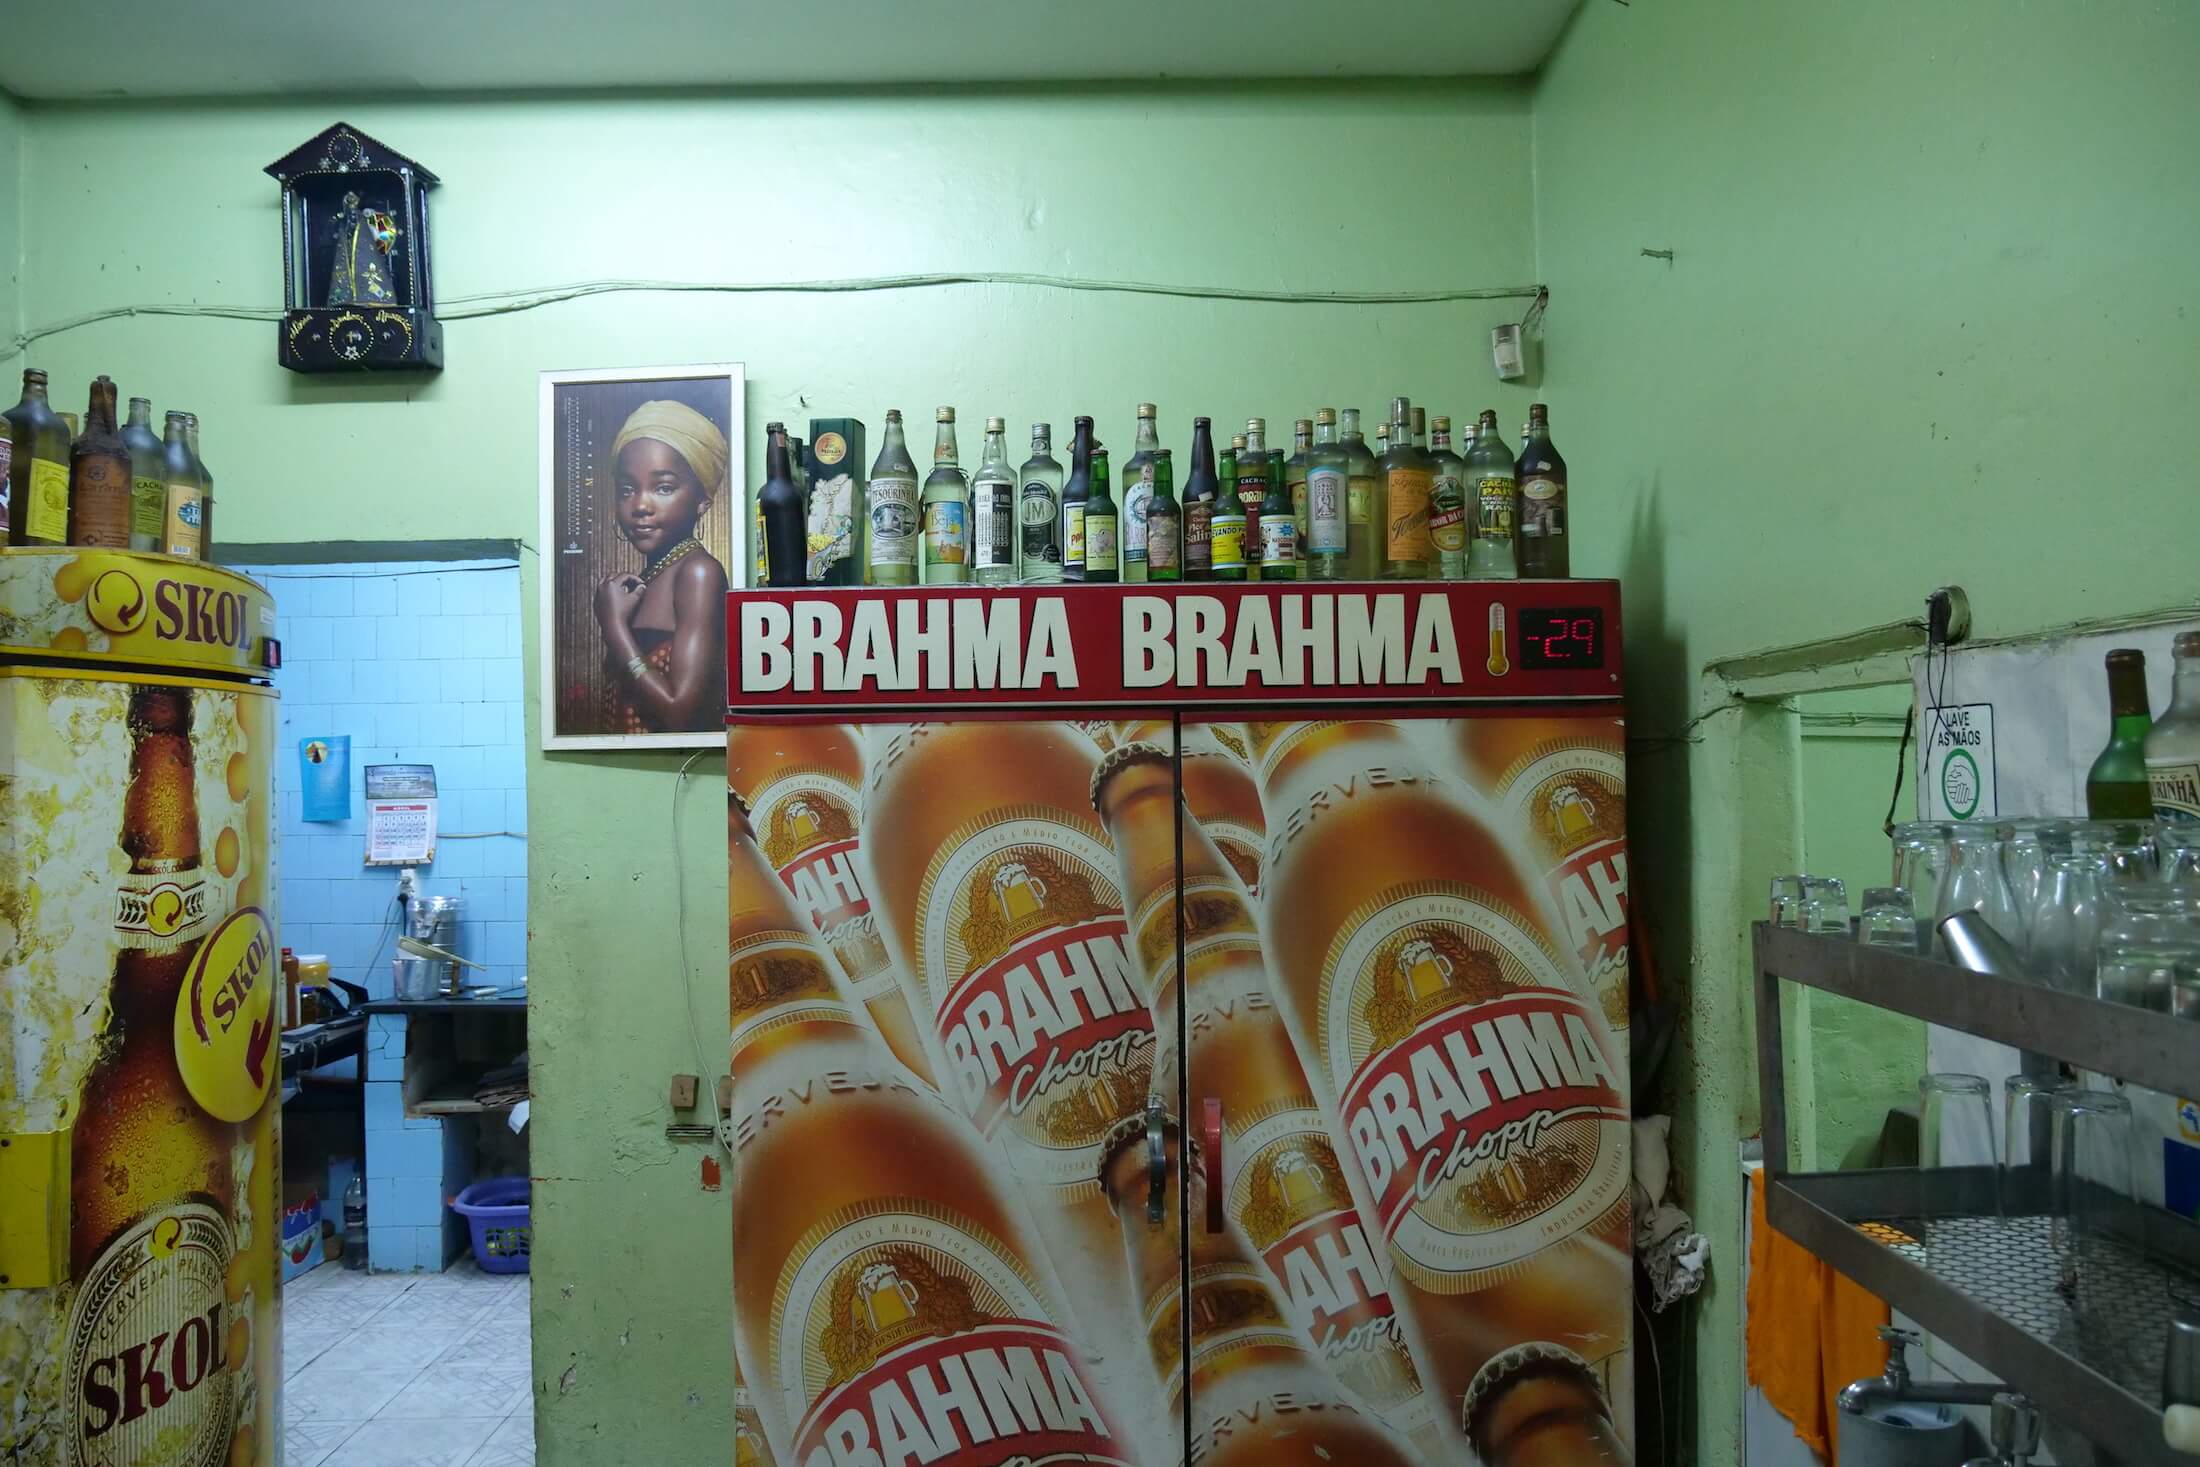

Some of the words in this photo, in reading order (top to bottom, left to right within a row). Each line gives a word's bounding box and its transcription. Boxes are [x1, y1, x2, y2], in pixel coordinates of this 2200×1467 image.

[155, 579, 251, 650] SKOL
[741, 597, 1079, 692] BRAHMA
[1123, 593, 1463, 689] BRAHMA
[1938, 732, 1949, 746] AS
[1953, 727, 1981, 746] MÃOS
[1946, 711, 1970, 728] LAVE
[1272, 767, 1444, 867] CERVEJA
[212, 932, 268, 1034] SKOL
[1009, 1028, 1156, 1117] Chopp
[1349, 1011, 1618, 1205] BRAHMA
[1416, 1108, 1562, 1201] Chopp
[99, 1269, 169, 1342] CERVEJA
[84, 1301, 227, 1441] SKOL
[804, 1345, 1112, 1466] RAHMA
